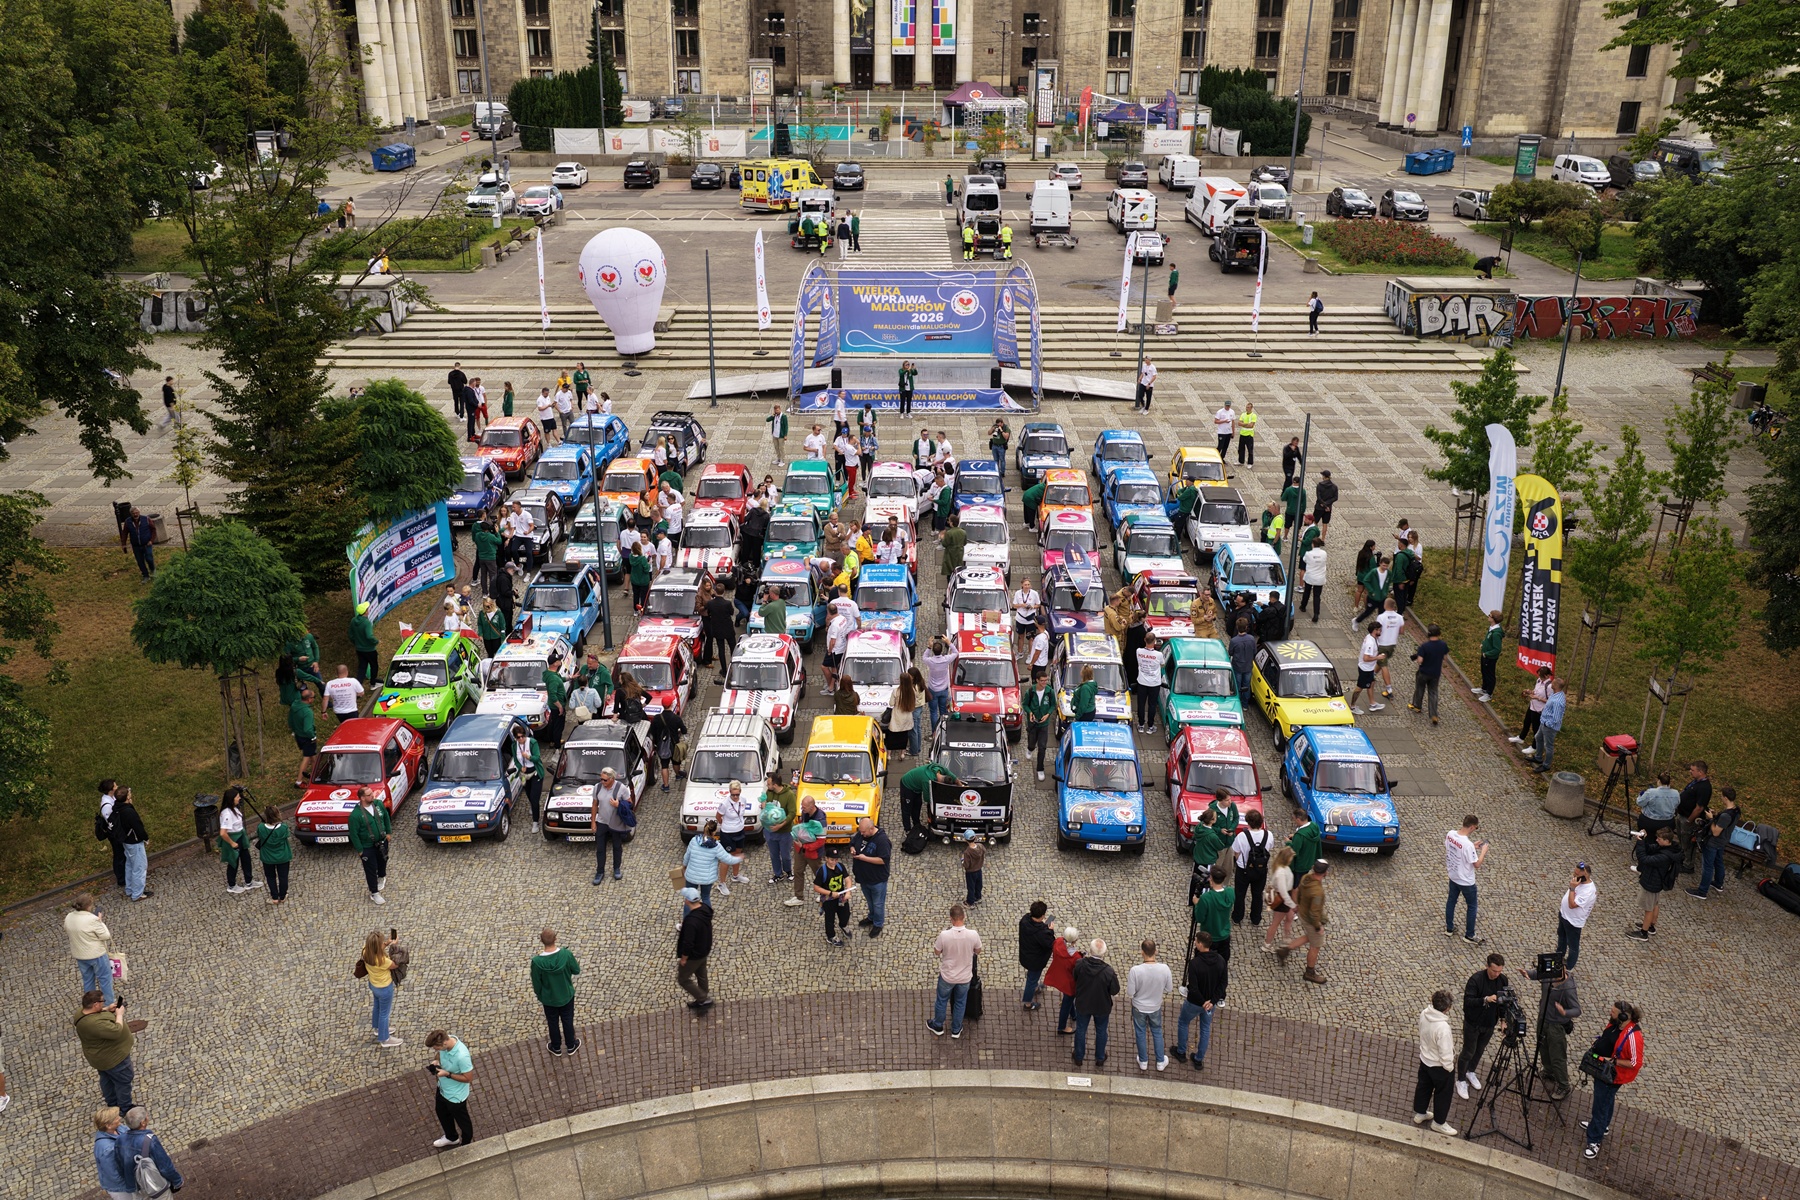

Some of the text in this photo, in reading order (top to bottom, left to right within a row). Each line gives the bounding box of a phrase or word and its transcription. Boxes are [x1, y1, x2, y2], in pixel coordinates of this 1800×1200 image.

[852, 286, 901, 295] WIELKA
[860, 294, 926, 304] WYPRAWA
[871, 301, 946, 312] MALUCHÓW
[911, 313, 944, 322] 2026
[928, 392, 976, 401] MALUCHÓW
[406, 521, 429, 536] Senetic
[376, 540, 394, 556] Senetic
[393, 540, 413, 554] Gabona
[410, 550, 433, 567] Senetic
[380, 571, 398, 587] Senetic
[396, 570, 416, 586] Gabona
[400, 692, 440, 704] SKOLNITY
[1447, 835, 1463, 849] POLAND
[829, 874, 843, 892] 67
